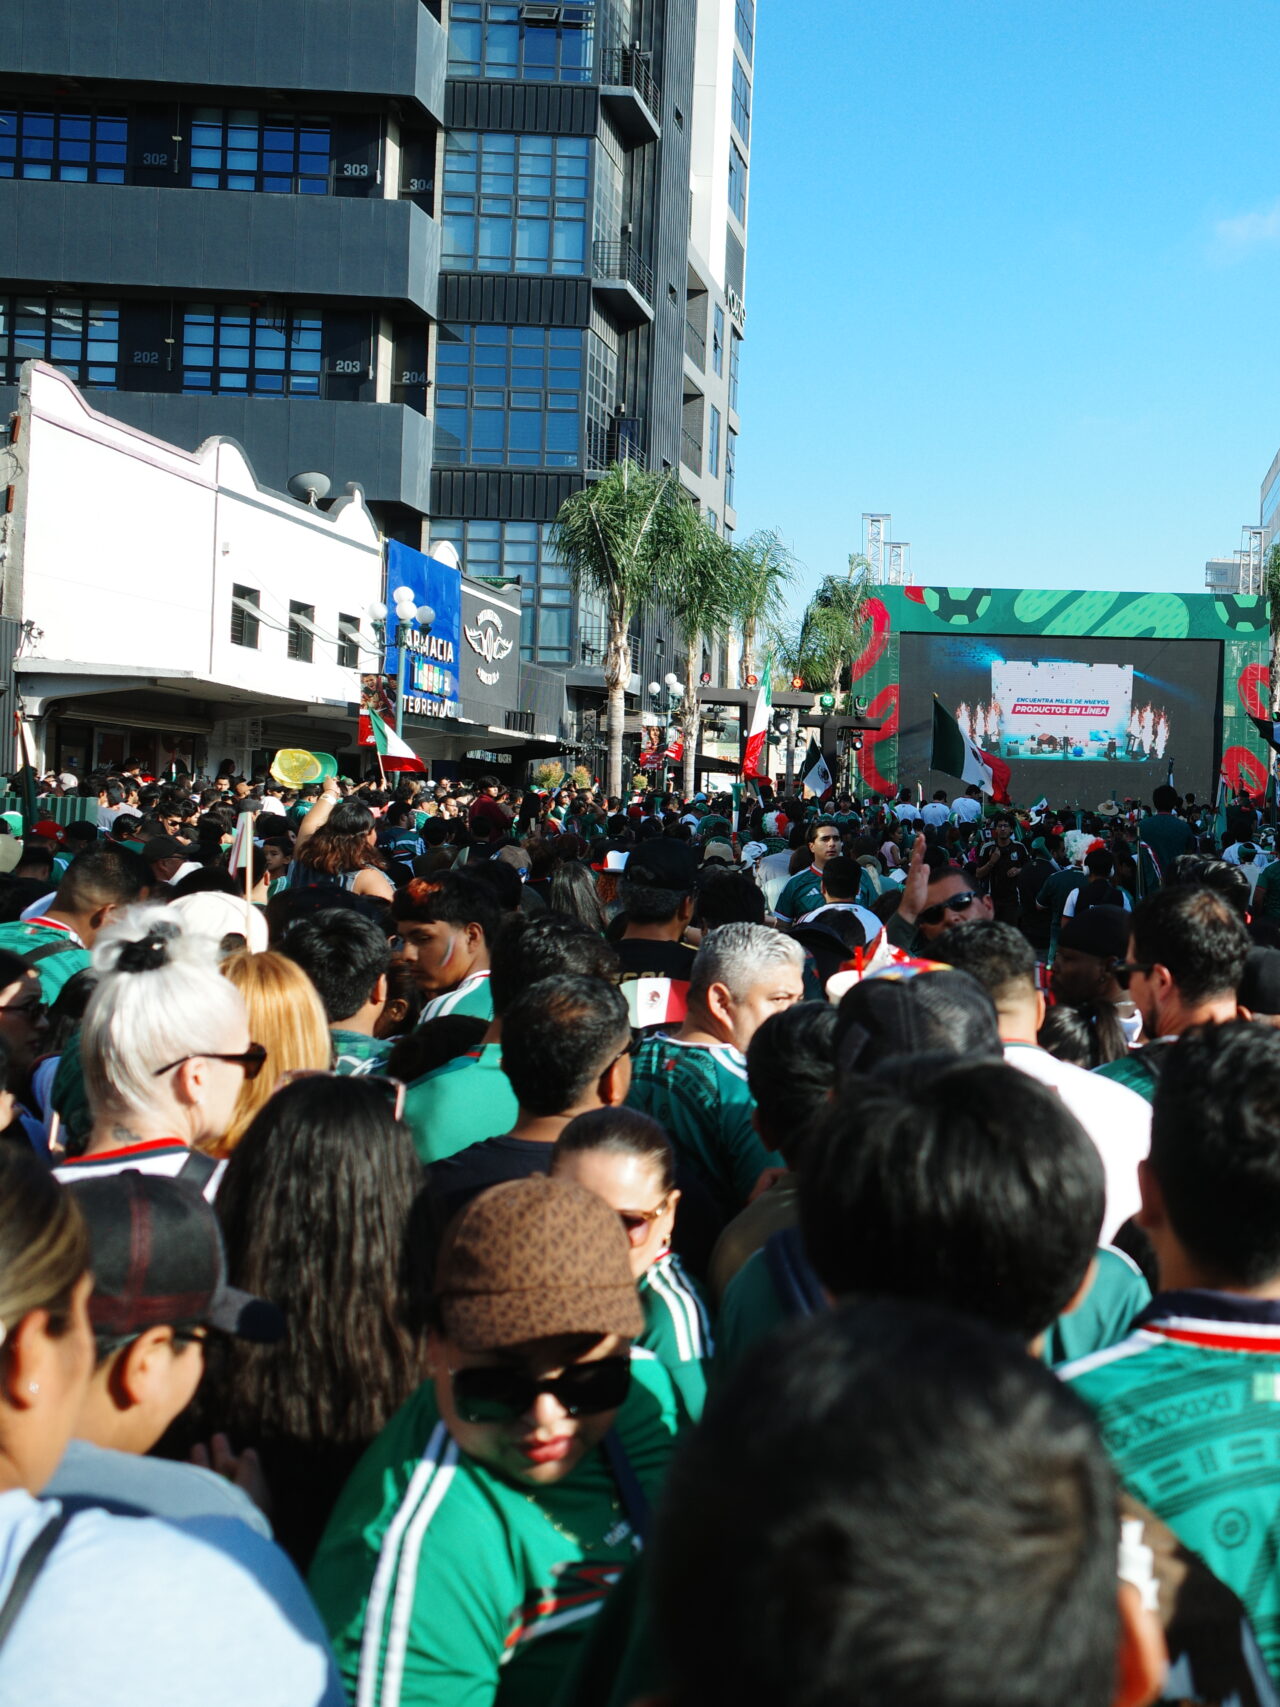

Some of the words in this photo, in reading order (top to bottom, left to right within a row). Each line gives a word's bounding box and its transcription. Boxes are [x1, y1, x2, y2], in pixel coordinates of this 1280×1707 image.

[143, 152, 168, 166] 302
[343, 163, 369, 177] 303
[409, 178, 433, 191] 304
[133, 351, 159, 364] 202
[335, 360, 361, 373] 203
[402, 371, 427, 383] 204
[406, 628, 454, 662] ARMACIA
[1015, 705, 1067, 714] PRODUCTOS
[1068, 706, 1081, 714] EN
[1081, 705, 1107, 715] LÍNEA
